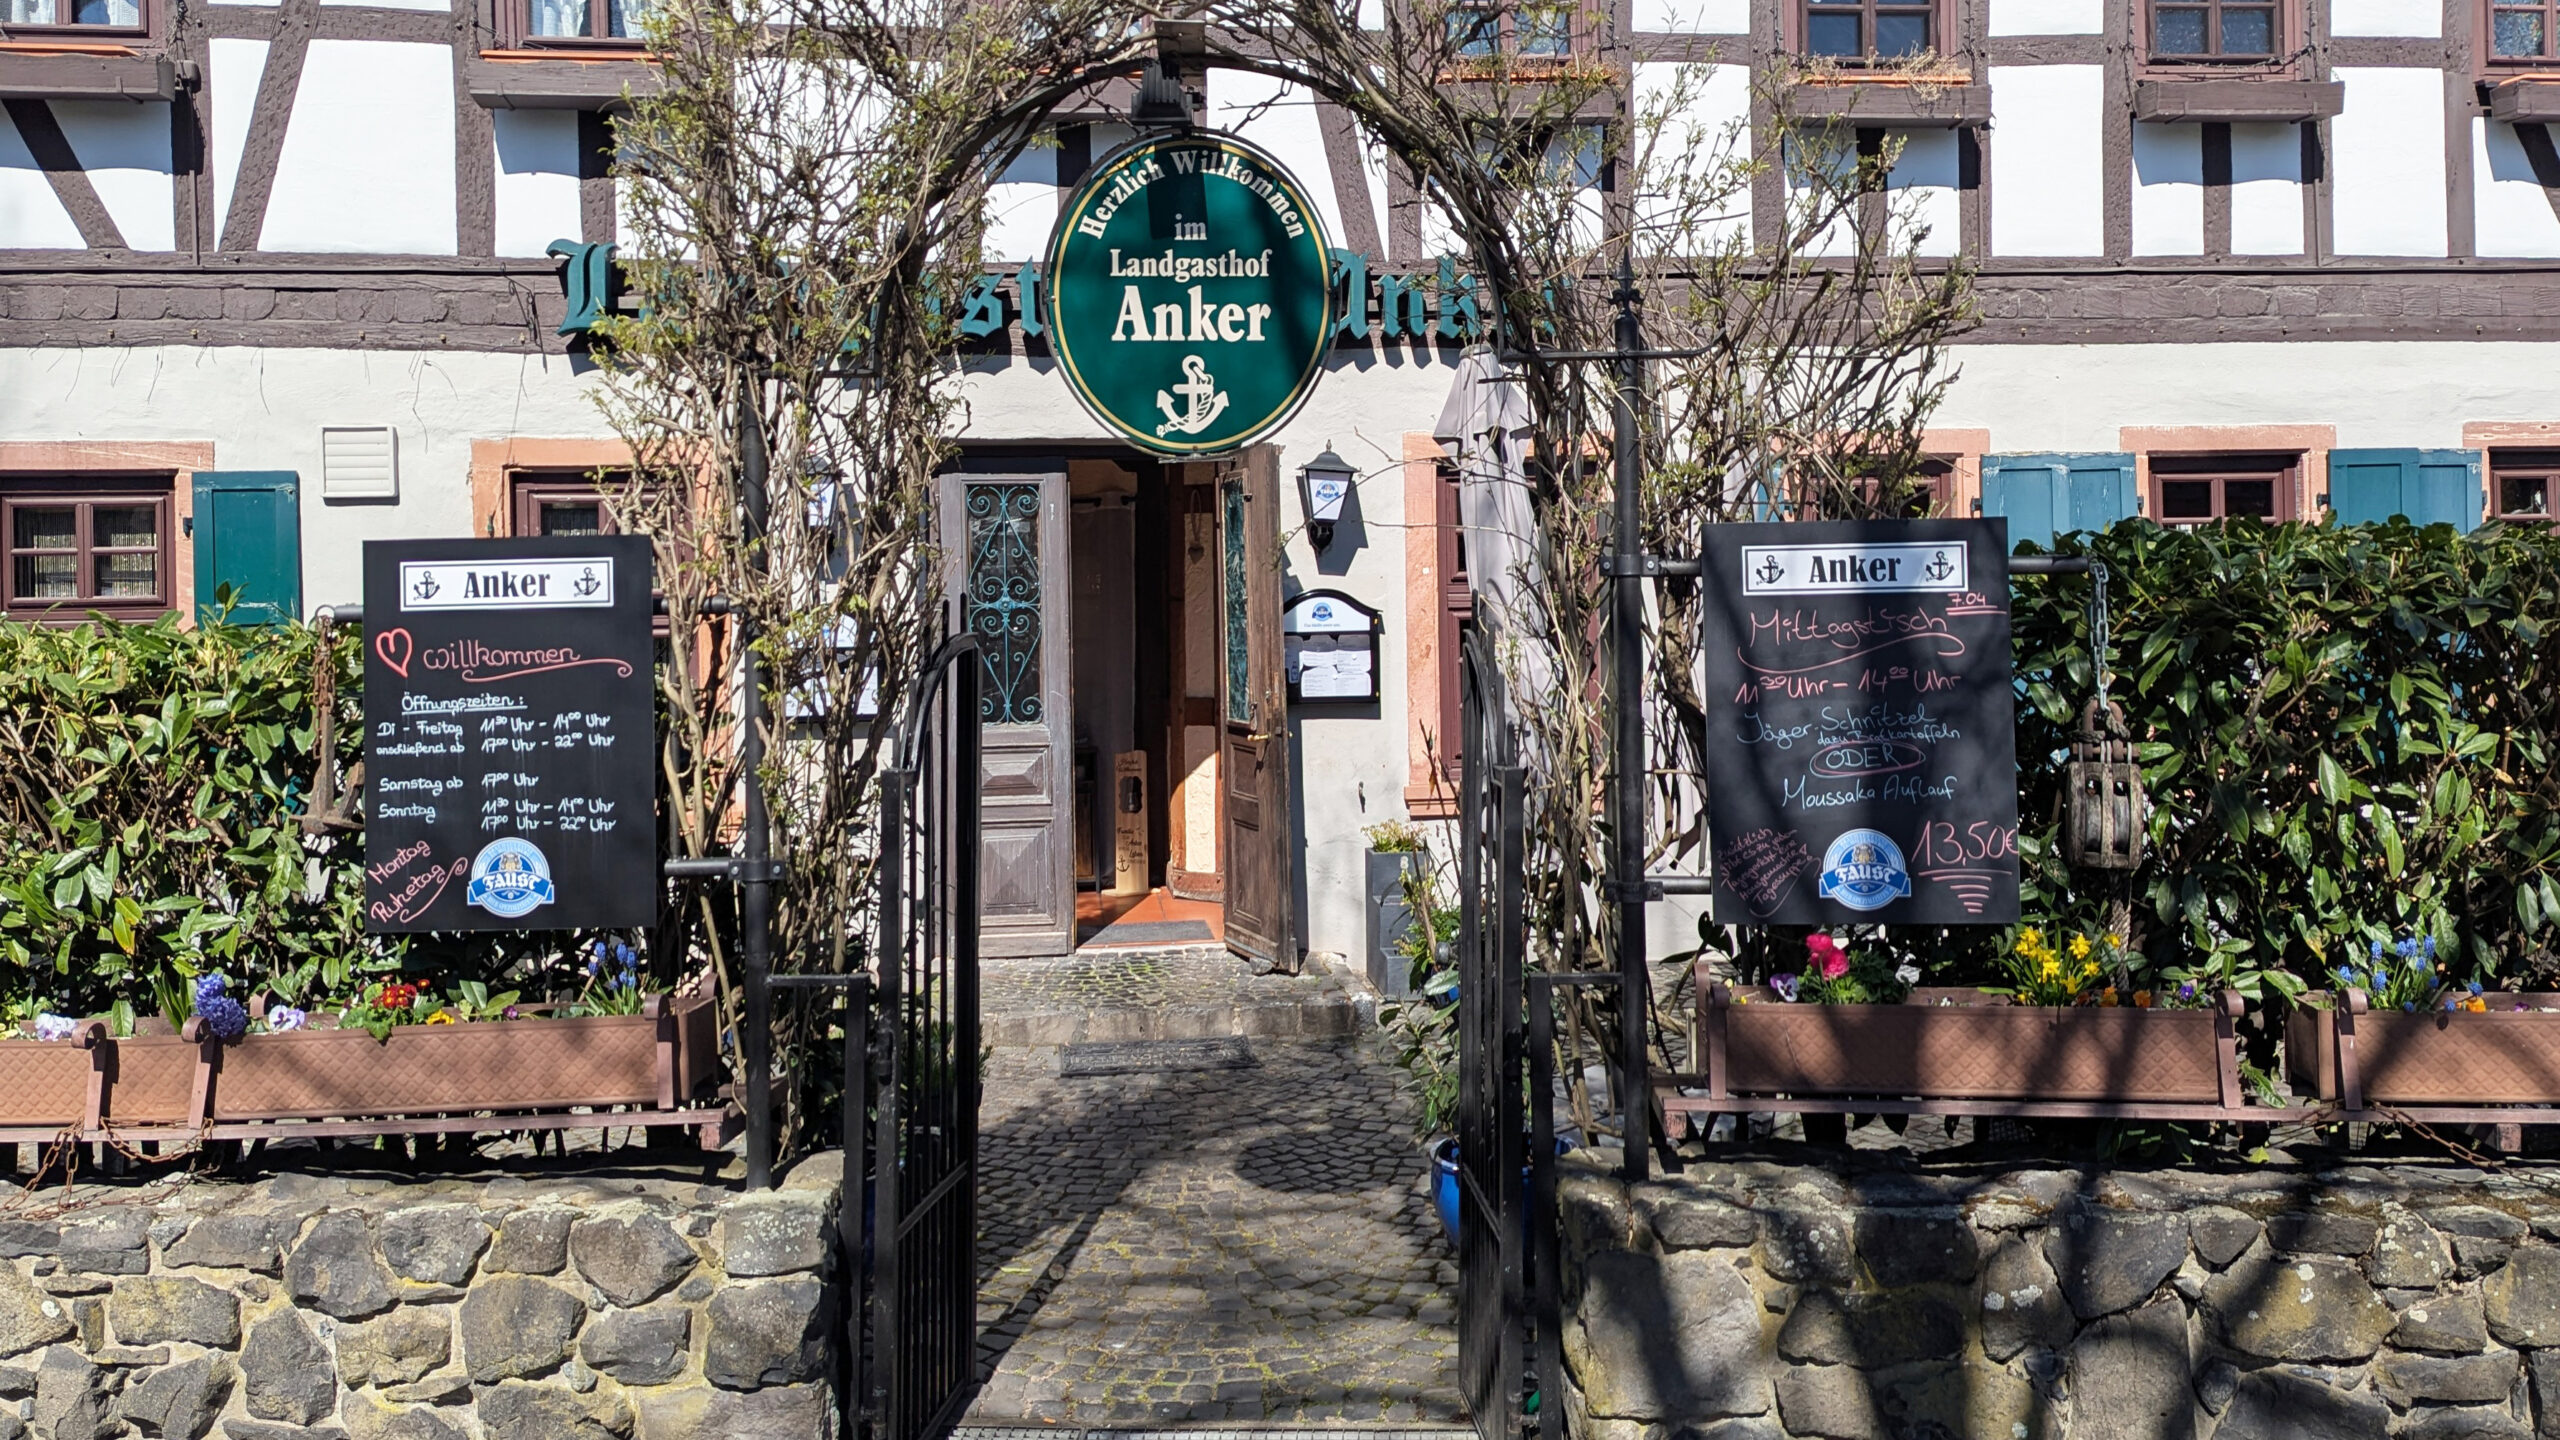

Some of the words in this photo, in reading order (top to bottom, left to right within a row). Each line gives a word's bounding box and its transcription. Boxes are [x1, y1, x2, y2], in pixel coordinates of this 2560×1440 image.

[1078, 156, 1165, 240] Herzlich
[1170, 150, 1305, 240] Willkommen
[1173, 213, 1207, 241] im
[1109, 248, 1273, 283] Landgasthof
[1111, 284, 1272, 342] Anker
[1809, 554, 1901, 584] Anker
[463, 570, 551, 599] Anker
[1750, 606, 1947, 650] Mittagstisch
[1786, 675, 1829, 699] Uhr
[1914, 671, 1961, 694] Uhr
[376, 721, 396, 737] Di
[416, 719, 464, 741] Freitag
[511, 717, 535, 733] Uhr
[586, 713, 610, 728] Uhr
[450, 741, 466, 753] ab
[512, 738, 536, 753] Uhr
[588, 734, 615, 748] Uhr
[1825, 743, 1901, 769] ODER
[378, 777, 443, 797] Samstag
[446, 776, 464, 789] ab
[513, 773, 540, 788] Uhr
[1782, 774, 1876, 810] Moussaka
[378, 802, 436, 824] Sonntag
[515, 799, 541, 813] Uhr
[588, 797, 615, 814] Uhr
[516, 815, 540, 831] Uhr
[589, 816, 617, 832] Uhr
[368, 840, 432, 885] Montag
[1834, 864, 1897, 884] FAUST
[371, 864, 446, 923] Ruhetag
[482, 871, 542, 892] FAUST
